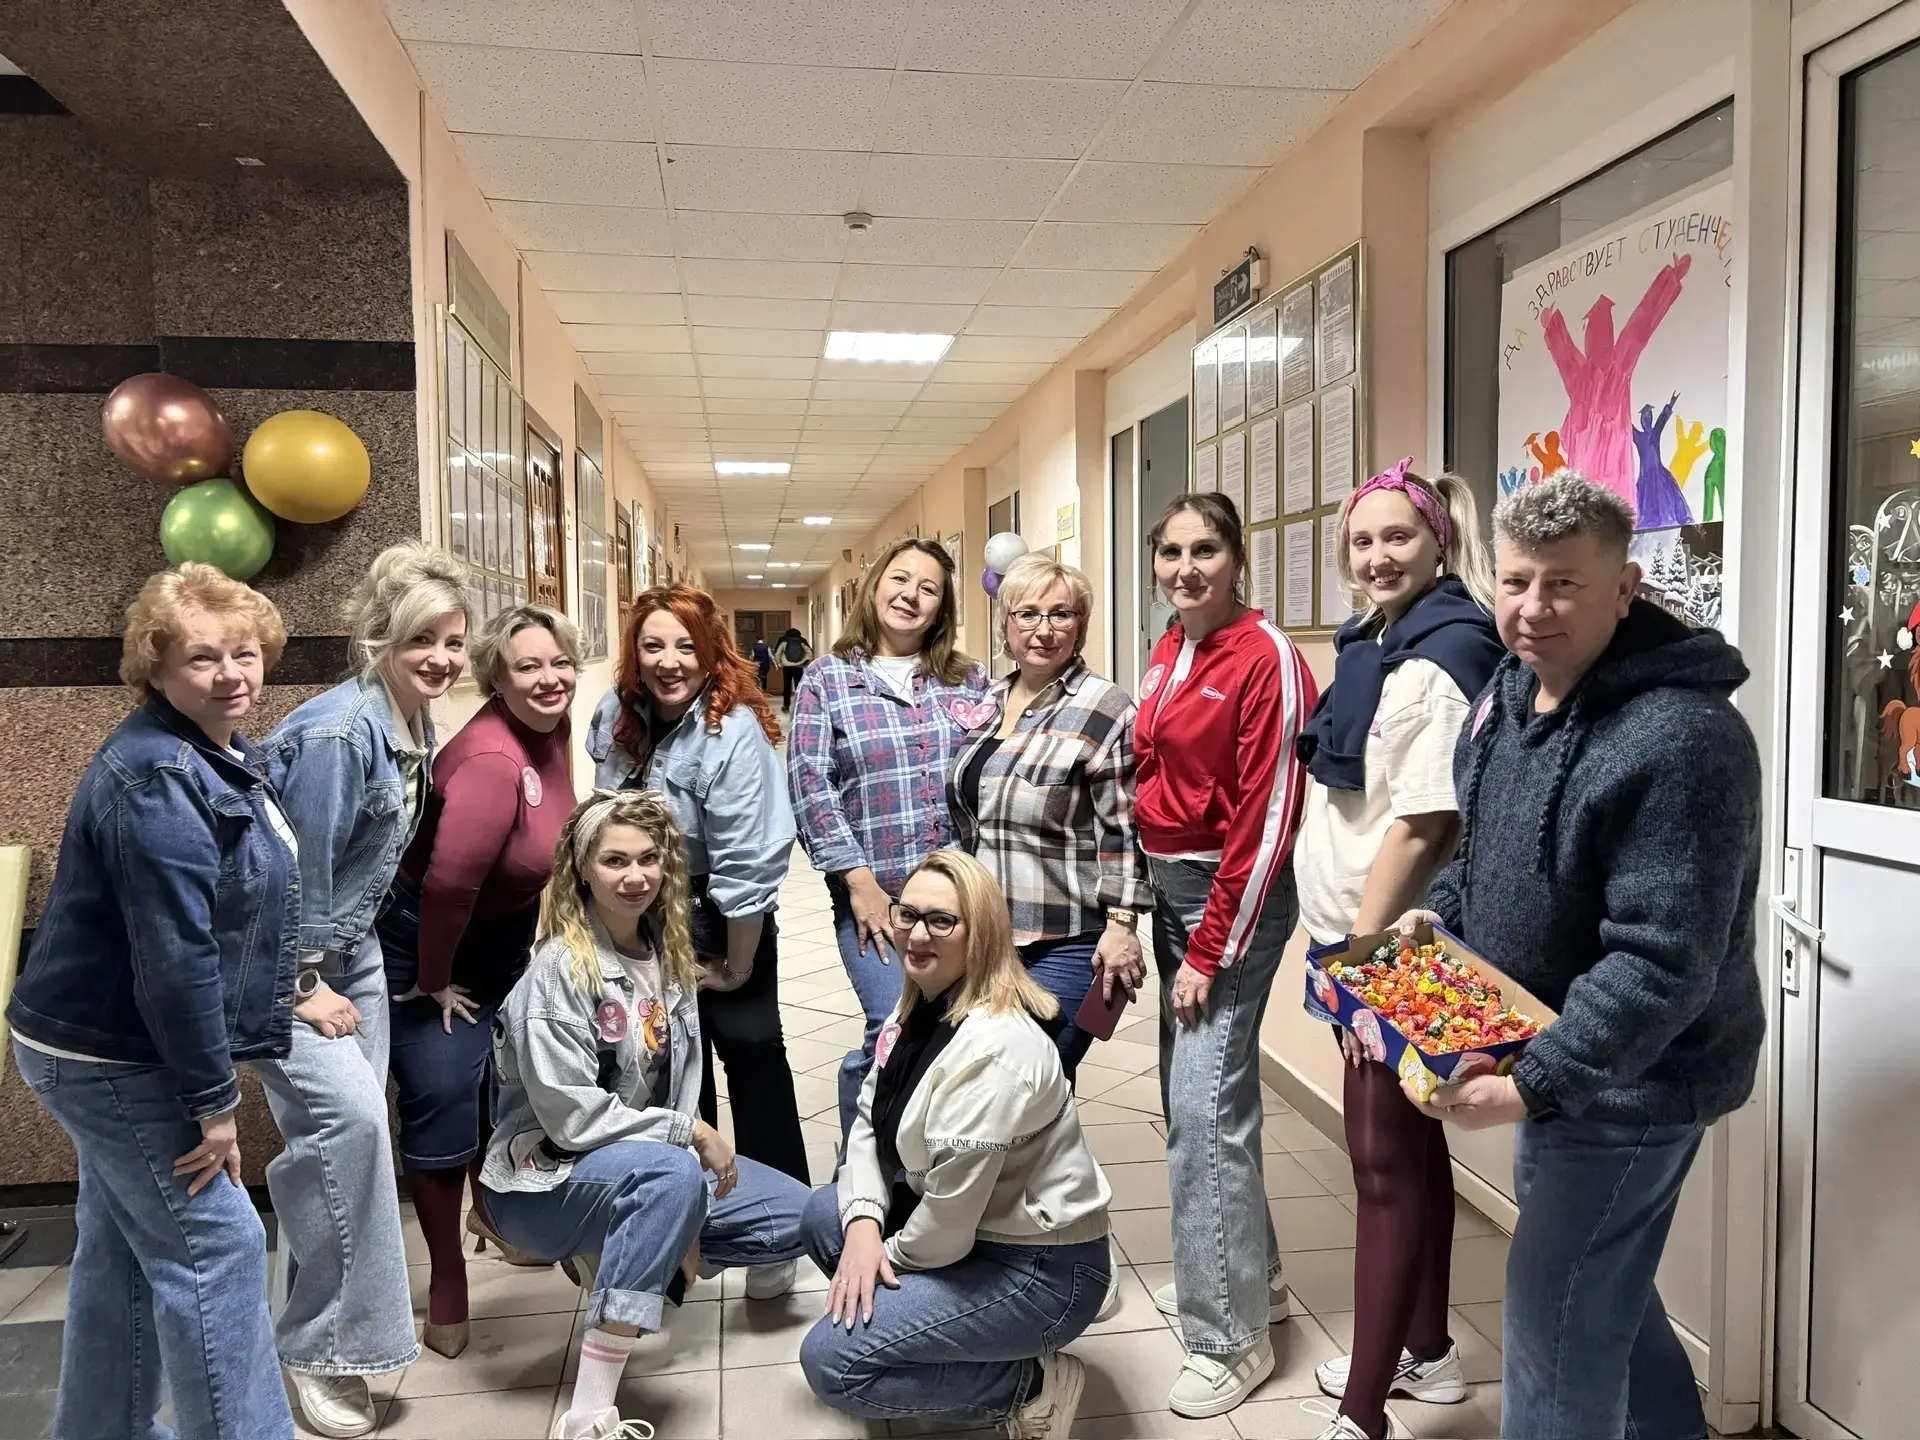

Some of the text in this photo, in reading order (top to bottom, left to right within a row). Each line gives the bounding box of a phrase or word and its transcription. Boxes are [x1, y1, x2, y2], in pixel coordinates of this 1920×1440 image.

[1503, 328, 1529, 370] ДА
[1527, 236, 1628, 321] ЗДРАВСТВУЕТ
[951, 1139, 971, 1149] LINE
